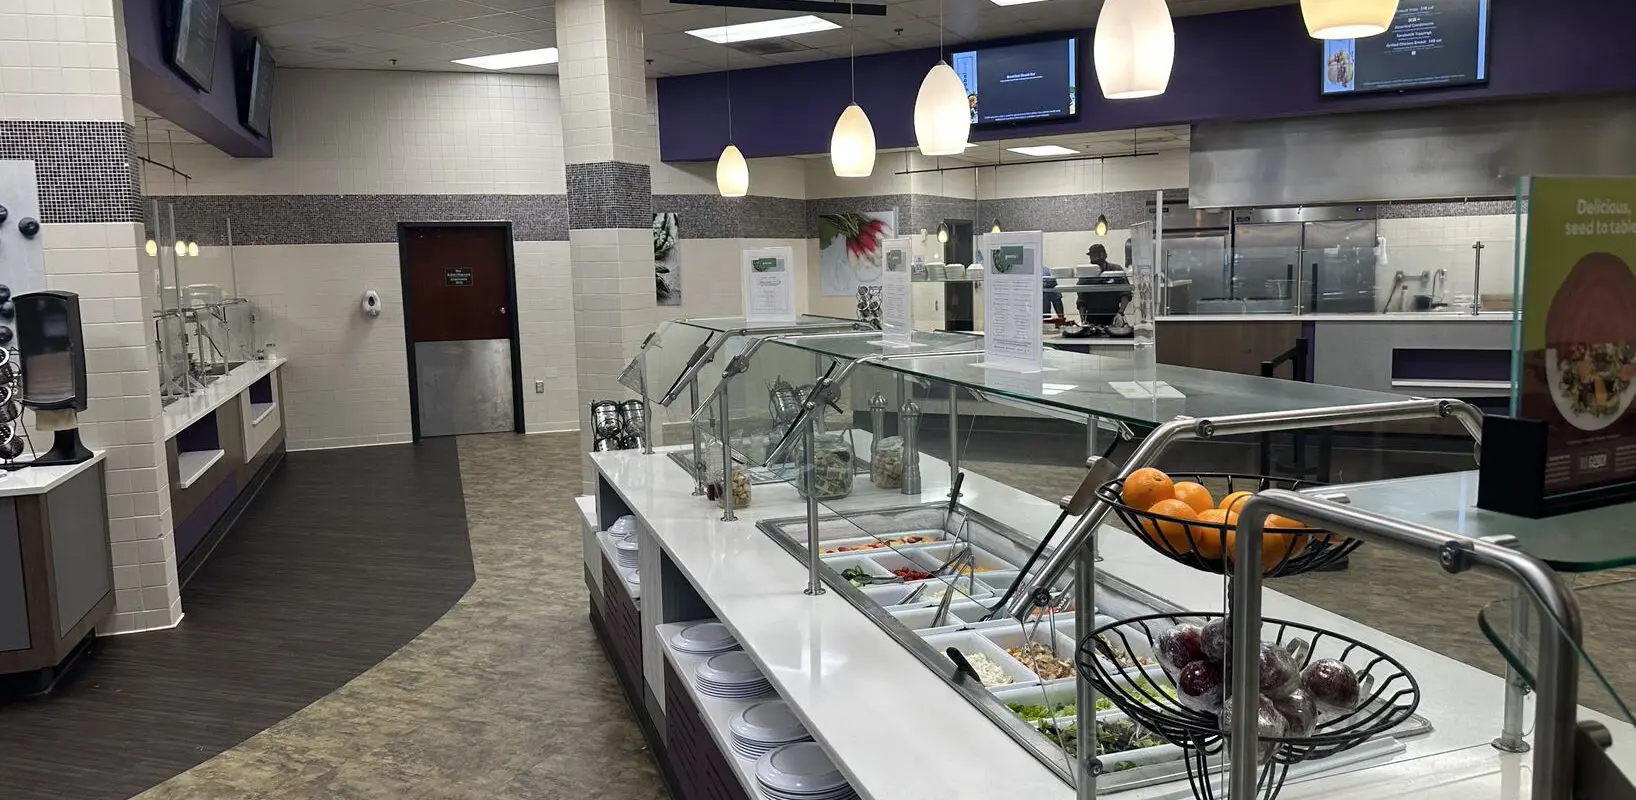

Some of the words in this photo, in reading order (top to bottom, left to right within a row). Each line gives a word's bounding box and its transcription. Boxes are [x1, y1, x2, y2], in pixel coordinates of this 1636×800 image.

[1576, 198, 1632, 216] Delicious,
[1565, 218, 1595, 235] seed
[1596, 219, 1608, 235] to
